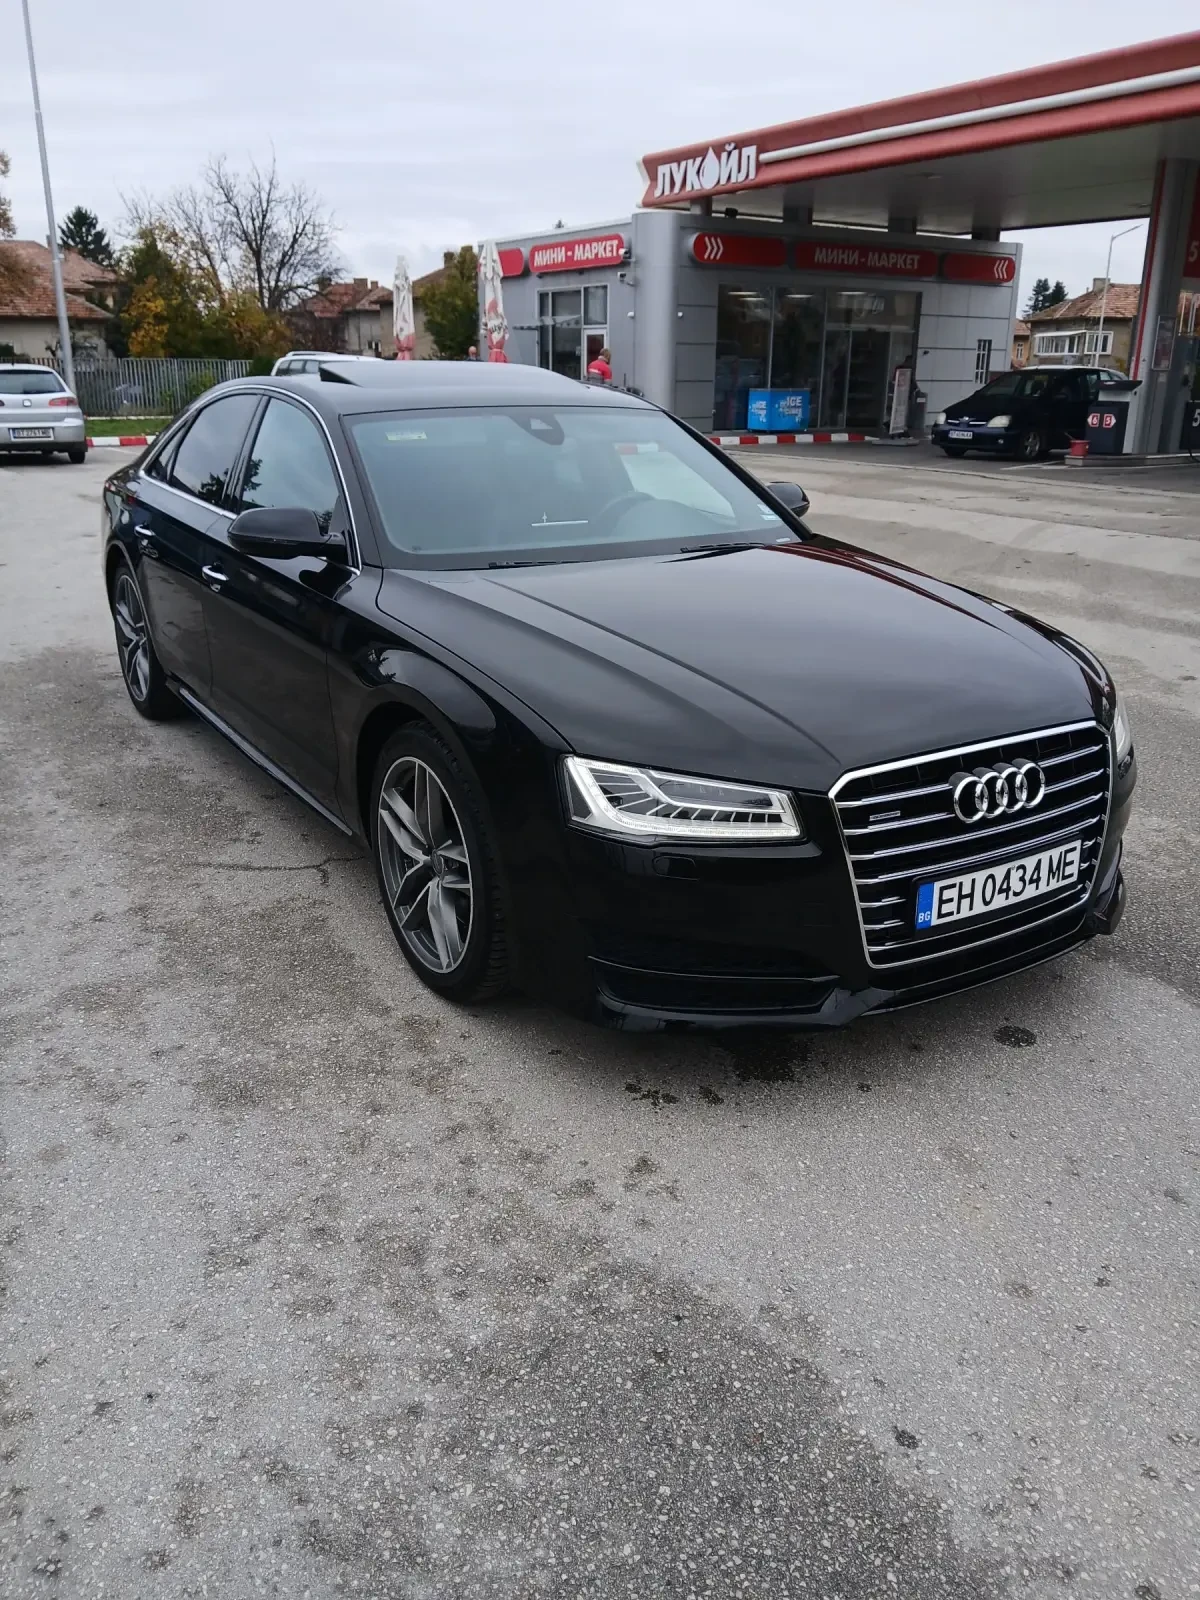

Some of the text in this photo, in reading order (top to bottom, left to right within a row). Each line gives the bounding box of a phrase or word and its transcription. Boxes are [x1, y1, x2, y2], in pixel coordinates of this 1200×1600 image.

[787, 396, 802, 406] ICE
[937, 846, 1078, 920] EH 0434 ME
[918, 911, 931, 923] BG
